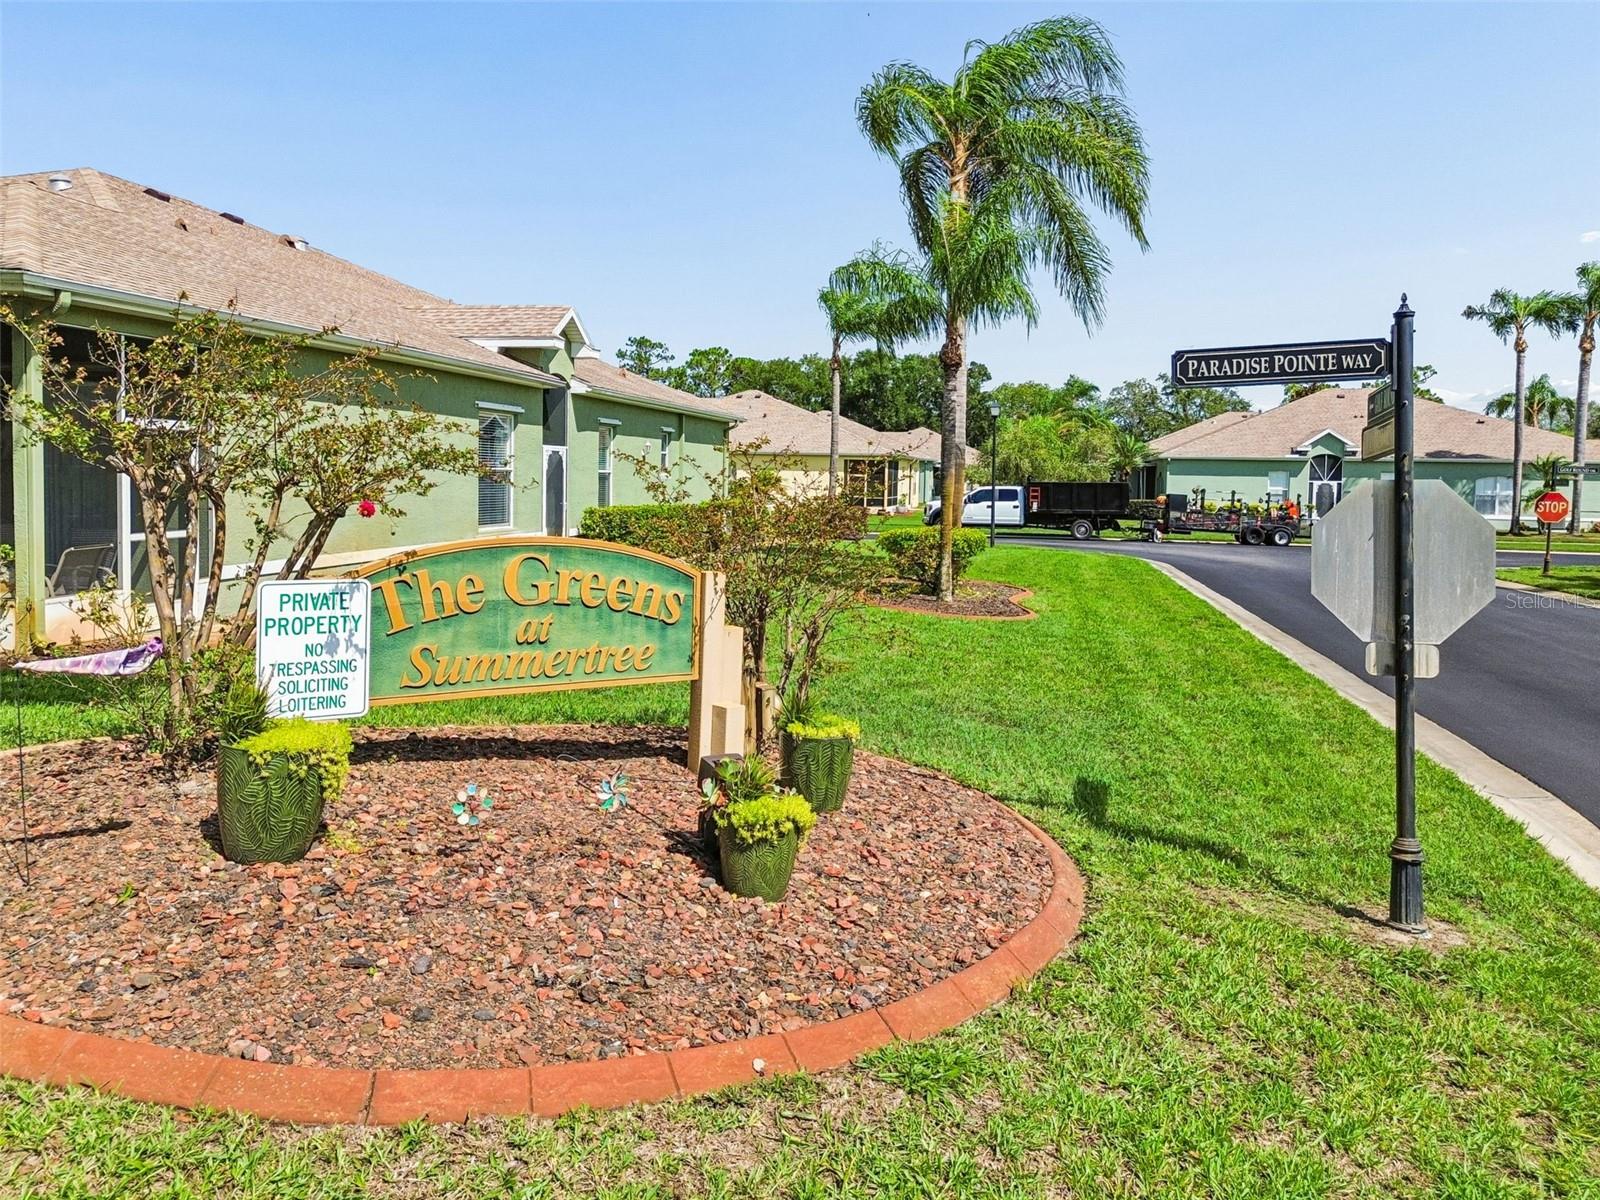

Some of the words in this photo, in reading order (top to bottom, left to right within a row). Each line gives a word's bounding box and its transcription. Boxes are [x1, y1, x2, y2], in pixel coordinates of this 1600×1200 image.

[1187, 357, 1270, 378] PARADISE
[1273, 353, 1337, 374] POINTE
[1341, 353, 1373, 370] WAY
[1537, 501, 1567, 513] STOP
[279, 592, 350, 612] PRIVATE
[373, 568, 486, 636] The
[503, 553, 685, 625] Greens
[264, 614, 362, 637] PROPERTY
[515, 611, 553, 644] at
[305, 642, 324, 657] NO
[269, 658, 358, 677] TRESPASSING
[400, 641, 656, 689] Summertree
[278, 676, 348, 695] SOLICITING
[279, 694, 347, 713] LOITERING
